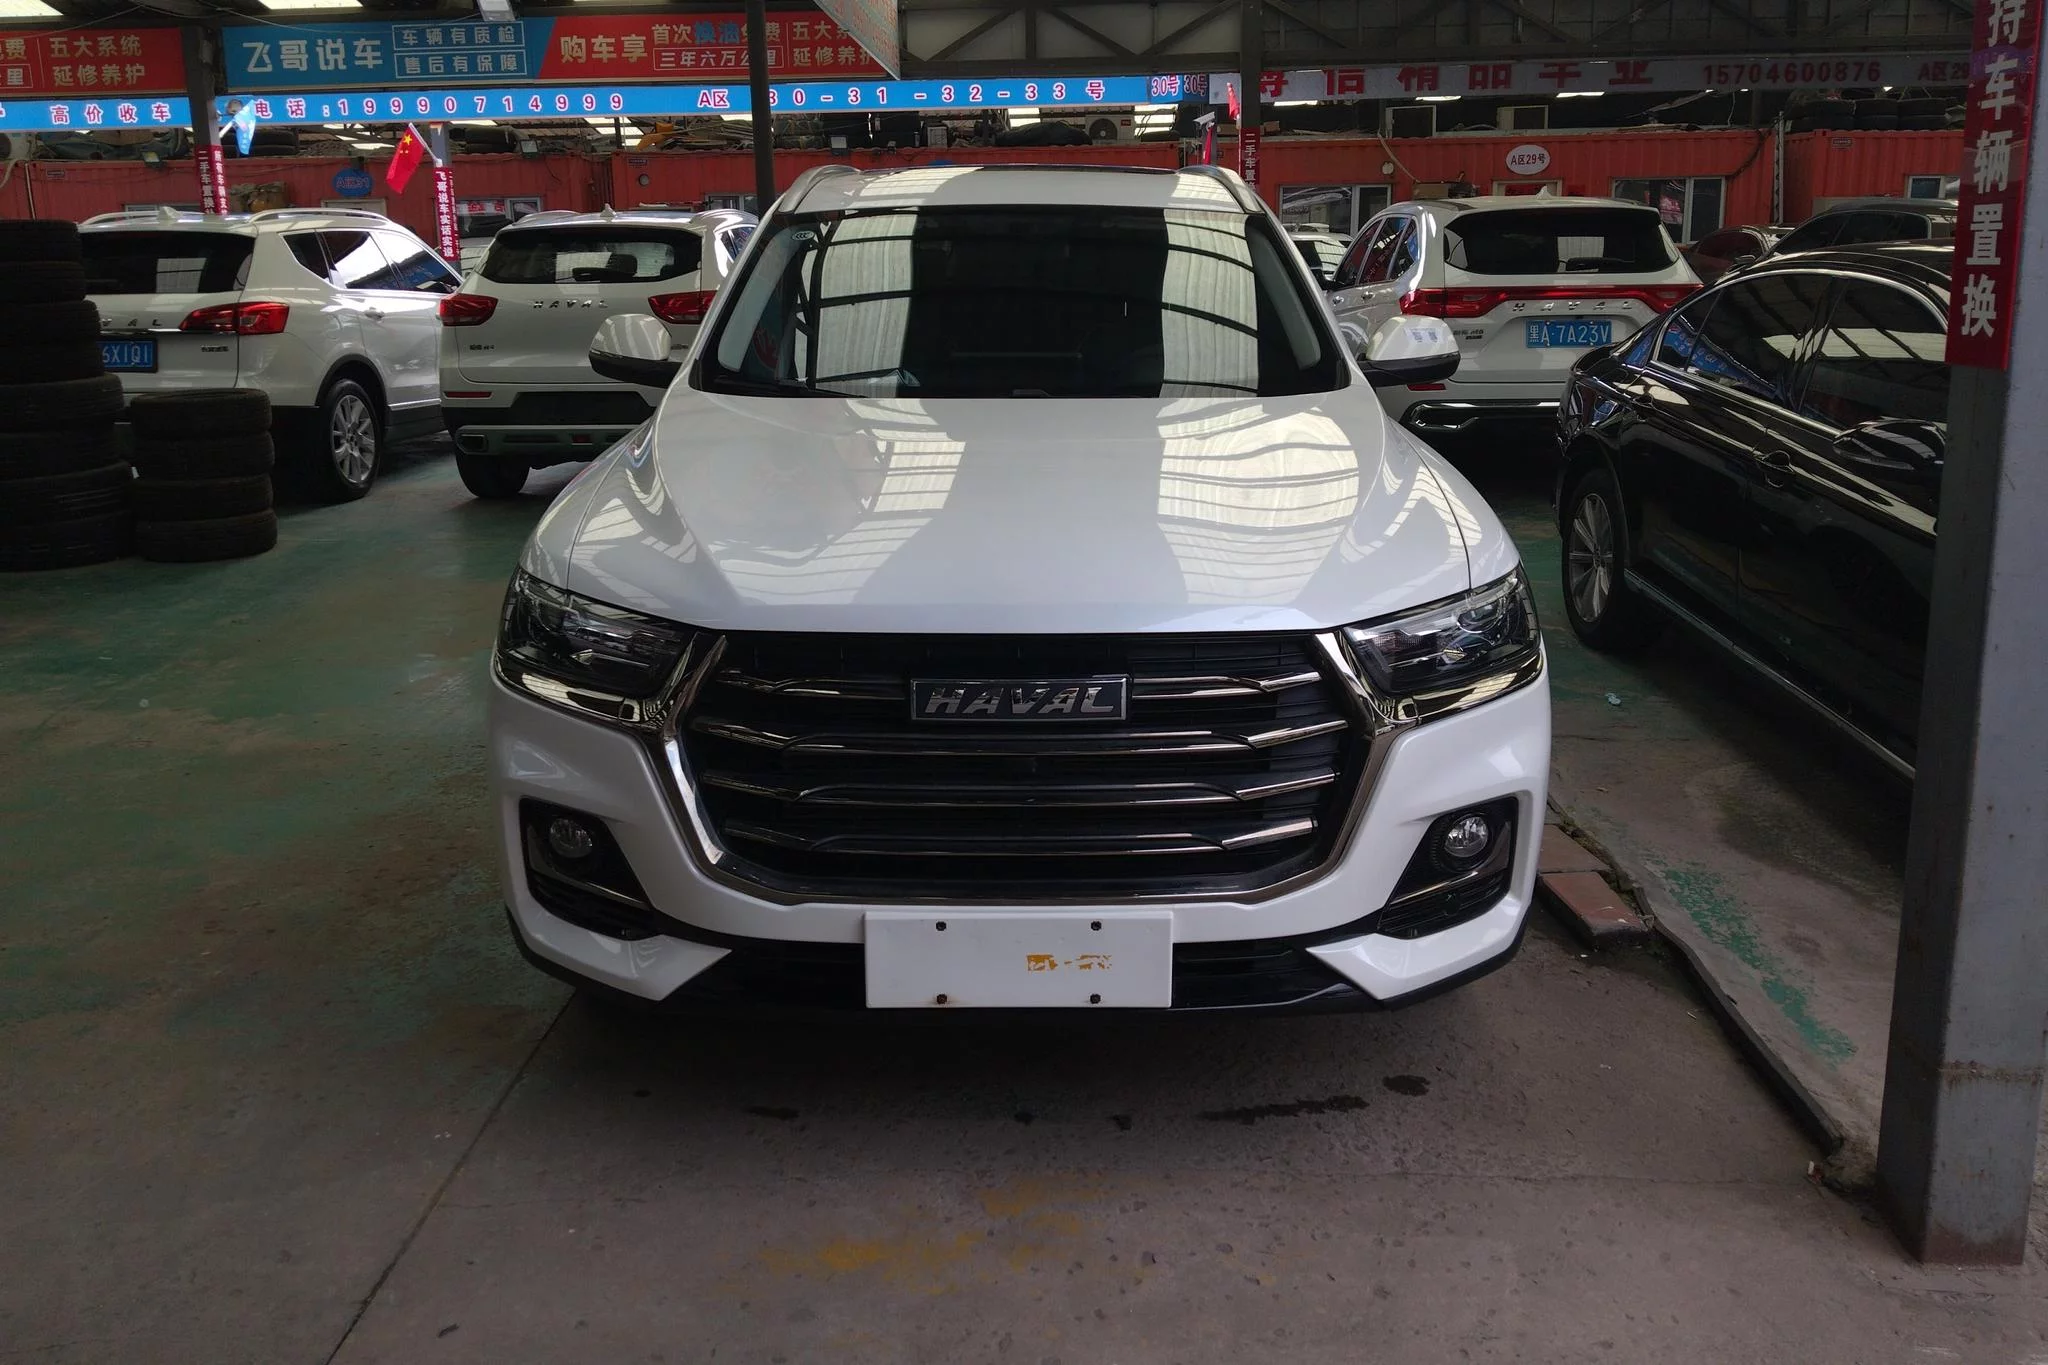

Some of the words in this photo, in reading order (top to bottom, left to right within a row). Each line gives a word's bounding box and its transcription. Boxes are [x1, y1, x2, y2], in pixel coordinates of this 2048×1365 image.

[402, 25, 518, 45] 车辆有质检
[0, 38, 28, 61] 费
[49, 35, 142, 59] 五大系统
[242, 38, 384, 73] 飞哥说车
[560, 34, 648, 63] 购车享
[52, 63, 146, 88] 延修养护
[403, 54, 519, 75] 售后有保障
[1703, 61, 1881, 85] 15704600876
[1151, 73, 1180, 97] 30号
[698, 89, 731, 109] A区
[51, 103, 172, 125] 高价收车
[1511, 153, 1546, 166] A区29号
[435, 171, 455, 257] 飞哥说车实话实说
[533, 299, 609, 309] HAVAL
[1512, 300, 1634, 313] HAVAL
[925, 687, 1114, 714] HAVAL
